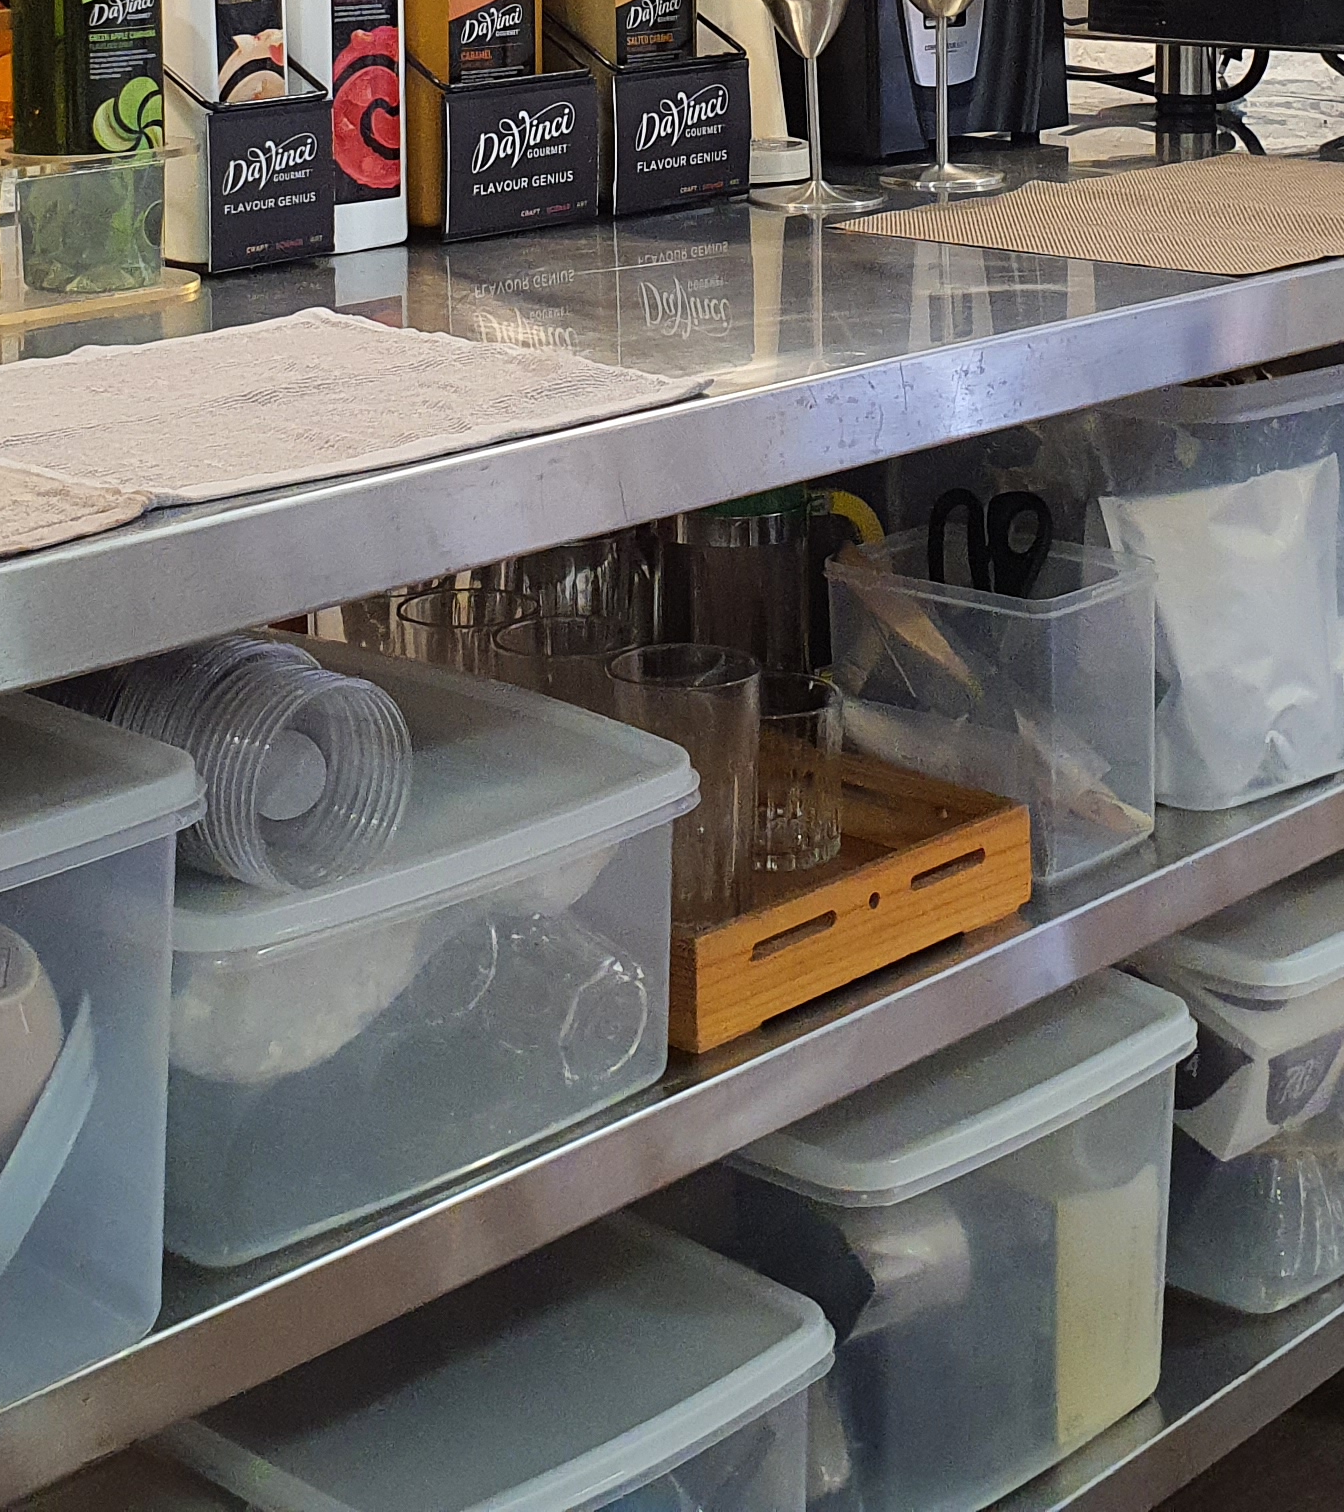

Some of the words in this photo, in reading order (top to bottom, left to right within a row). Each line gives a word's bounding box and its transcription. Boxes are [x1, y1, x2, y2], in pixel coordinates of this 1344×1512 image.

[460, 3, 522, 44] DaVinci
[635, 84, 729, 151] DaVinci
[471, 101, 575, 174] DaVinci
[685, 125, 722, 138] GOURMET
[527, 144, 567, 158] GOURMET
[637, 156, 687, 173] FLAVOUR
[689, 149, 728, 165] GENIUS
[222, 132, 318, 196] DaVinci
[273, 169, 310, 182] GOURMET
[473, 178, 528, 196] FLAVOUR
[531, 171, 574, 186] GENIUS
[224, 199, 275, 215] FLAVOUR
[278, 191, 316, 206] GENIUS
